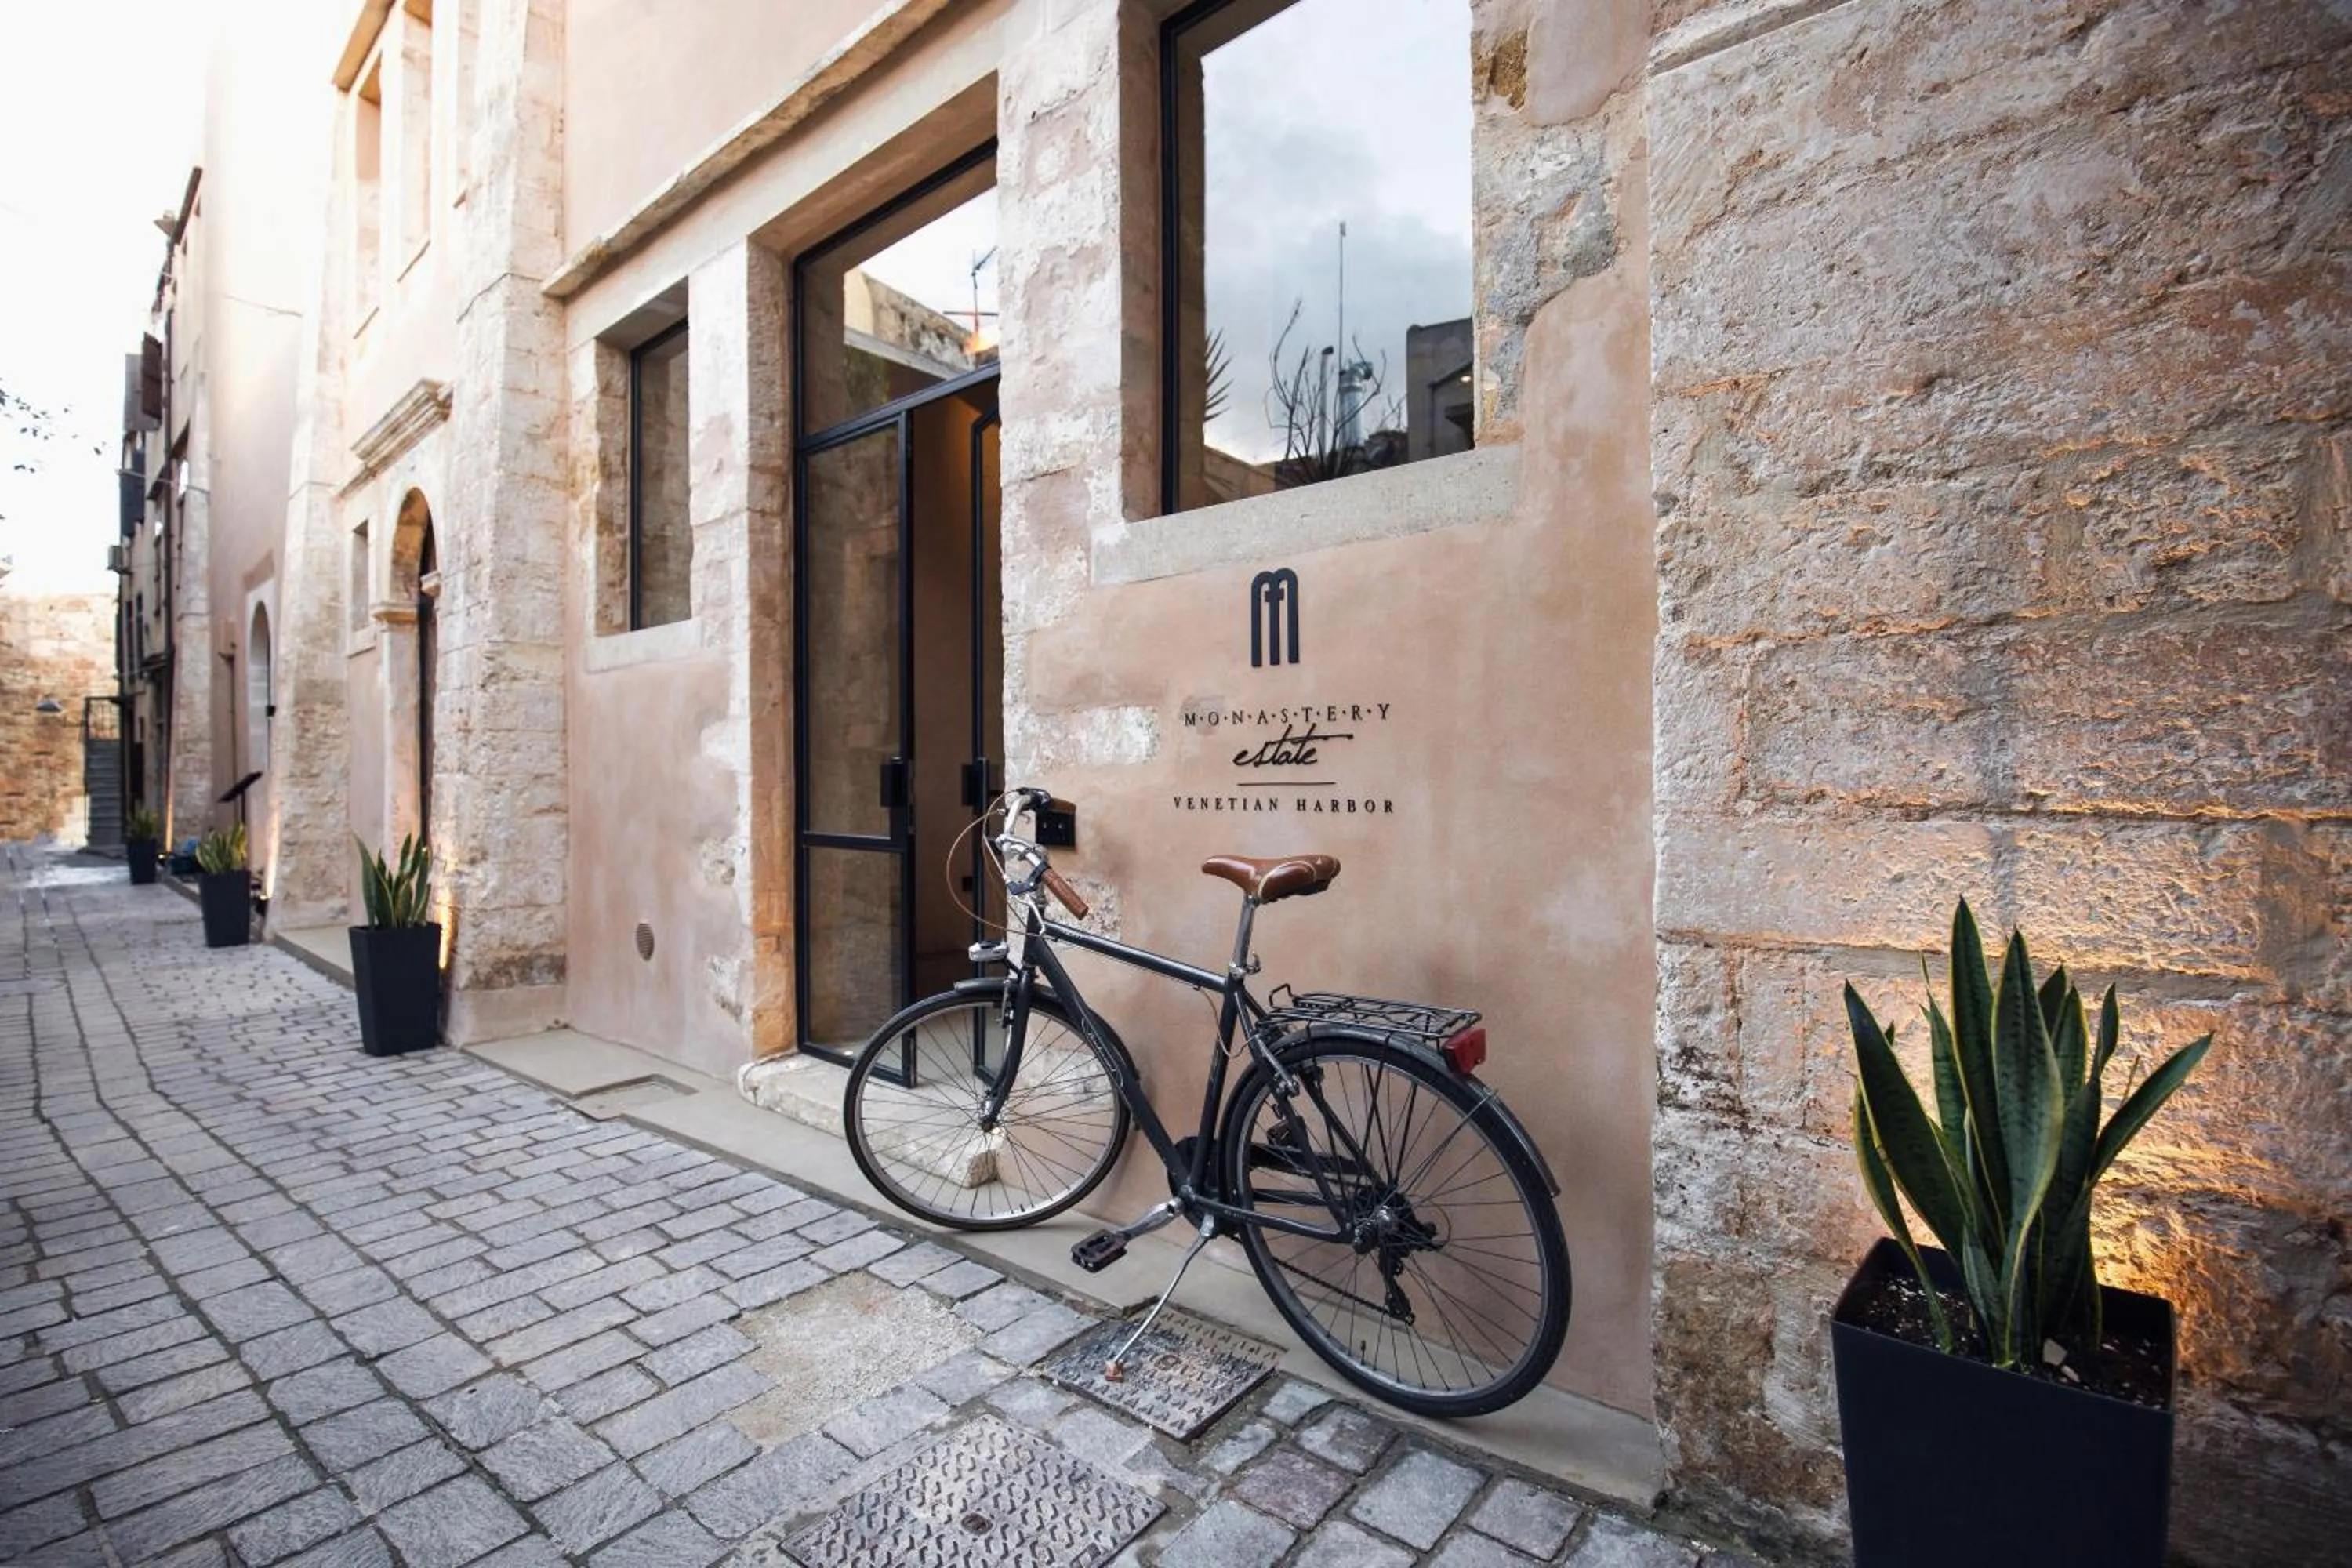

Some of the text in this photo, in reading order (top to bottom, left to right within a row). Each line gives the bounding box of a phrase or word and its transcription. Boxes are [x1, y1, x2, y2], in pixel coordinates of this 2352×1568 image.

[1232, 723, 1354, 768] estate
[1174, 796, 1393, 813] VENETIAN HARBOR
